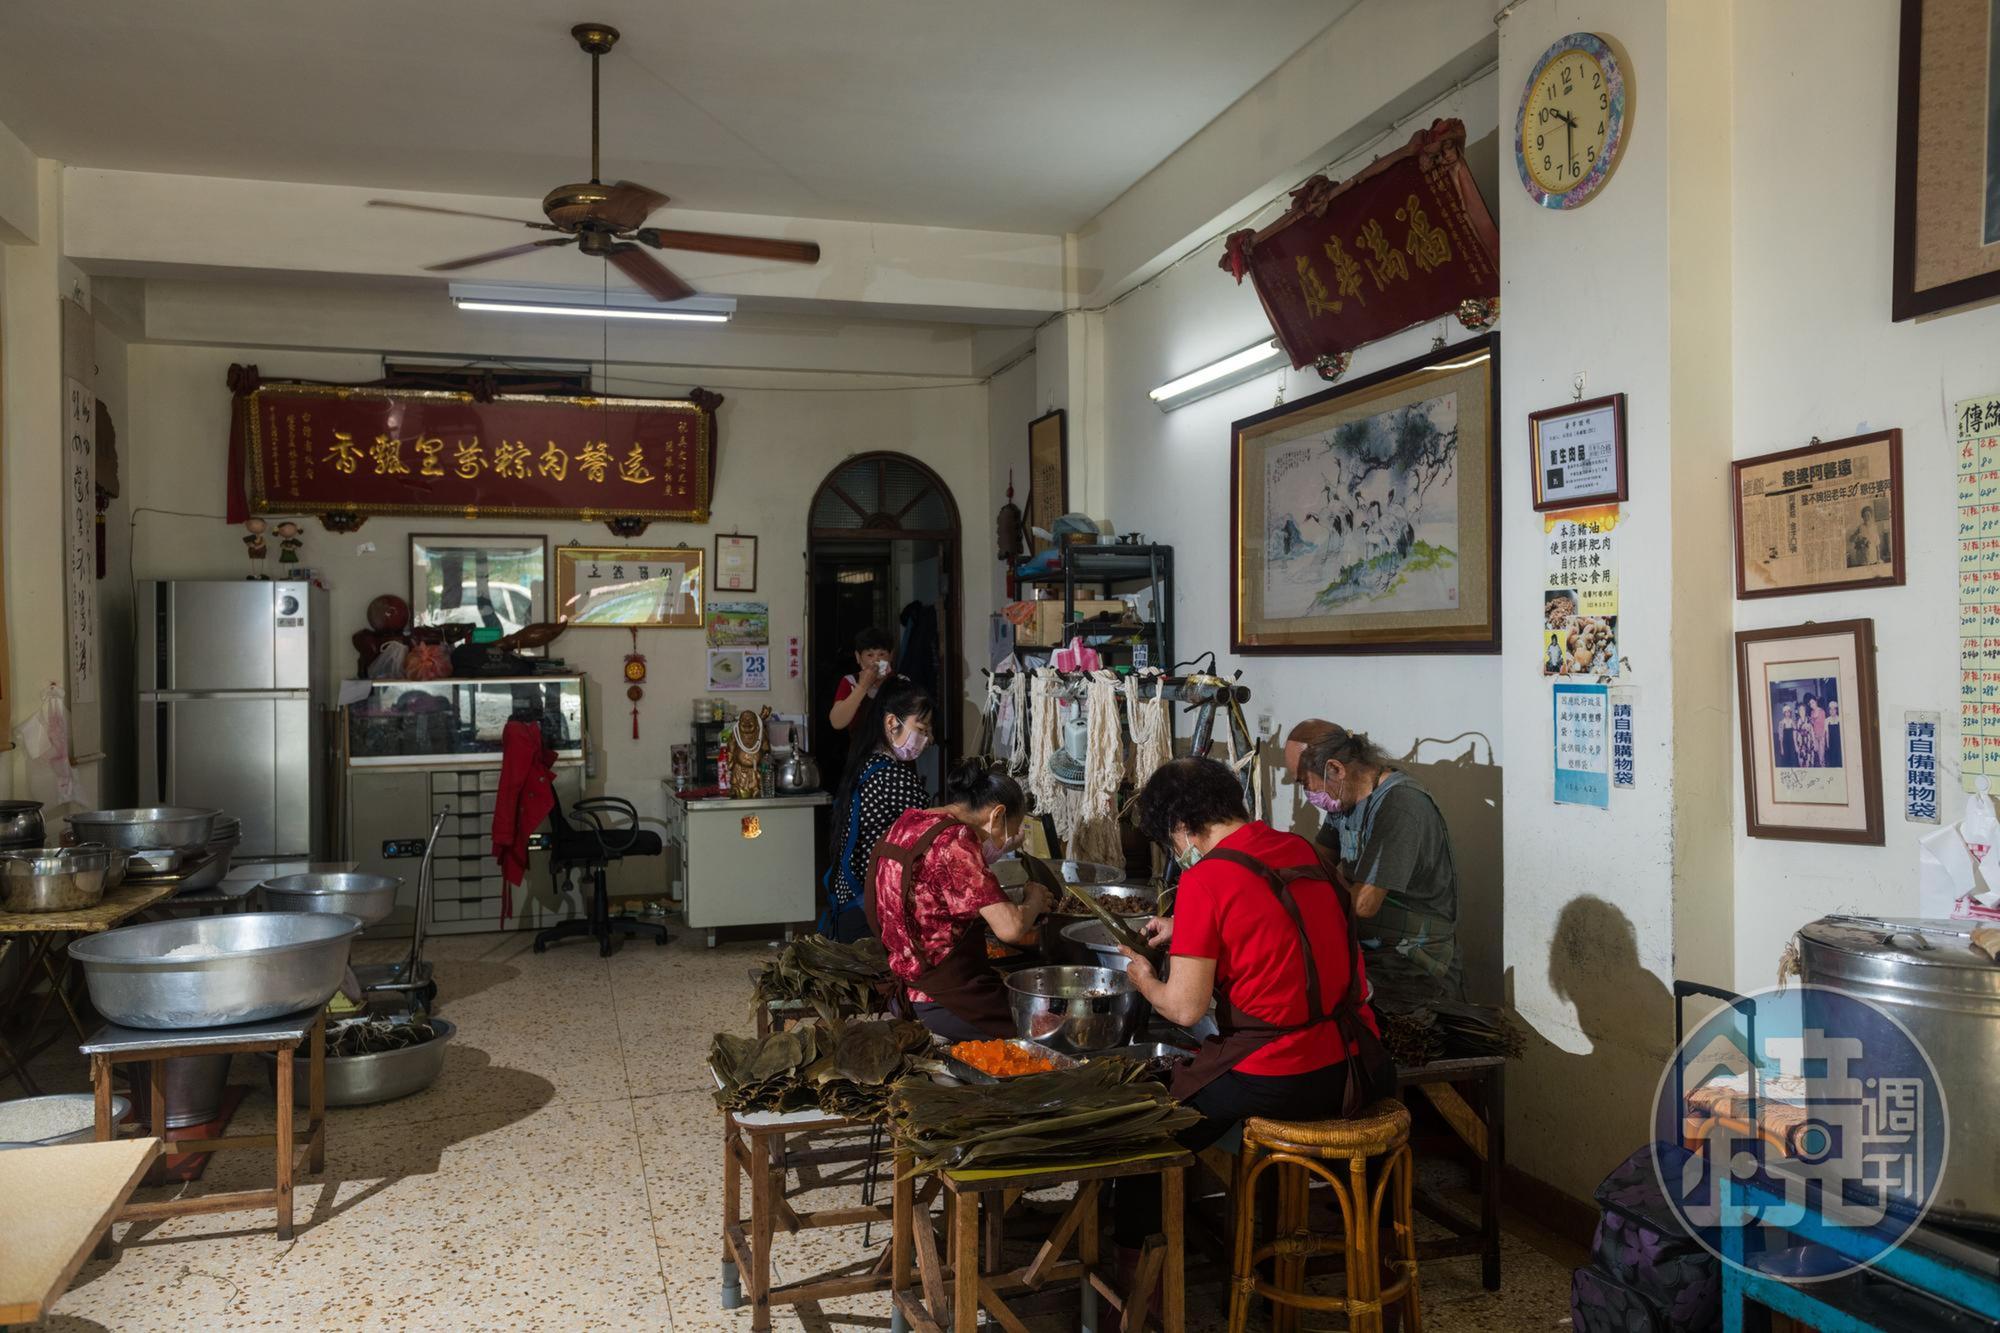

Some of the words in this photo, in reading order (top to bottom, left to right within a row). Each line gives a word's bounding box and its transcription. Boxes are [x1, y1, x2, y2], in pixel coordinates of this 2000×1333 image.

[1561, 67, 1572, 84] 12
[1579, 64, 1584, 78] 1
[1593, 73, 1600, 90] 2
[1548, 84, 1556, 100] 11
[1600, 93, 1608, 110] 3
[1538, 108, 1549, 126] 10
[1598, 121, 1604, 136] 4
[1537, 135, 1544, 150] 9
[1587, 146, 1595, 162] 5
[1544, 155, 1552, 171] 8
[1572, 161, 1580, 178] 6
[1556, 164, 1563, 181] 7
[1550, 536, 1610, 554] 使用新鮮肥肉
[1561, 553, 1600, 569] 自行熬煉
[1550, 570, 1610, 586] 敬請安心食用
[746, 656, 765, 672] 23
[1614, 704, 1633, 784] 請自備購物袋
[1908, 722, 1936, 818] 請自備購物袋
